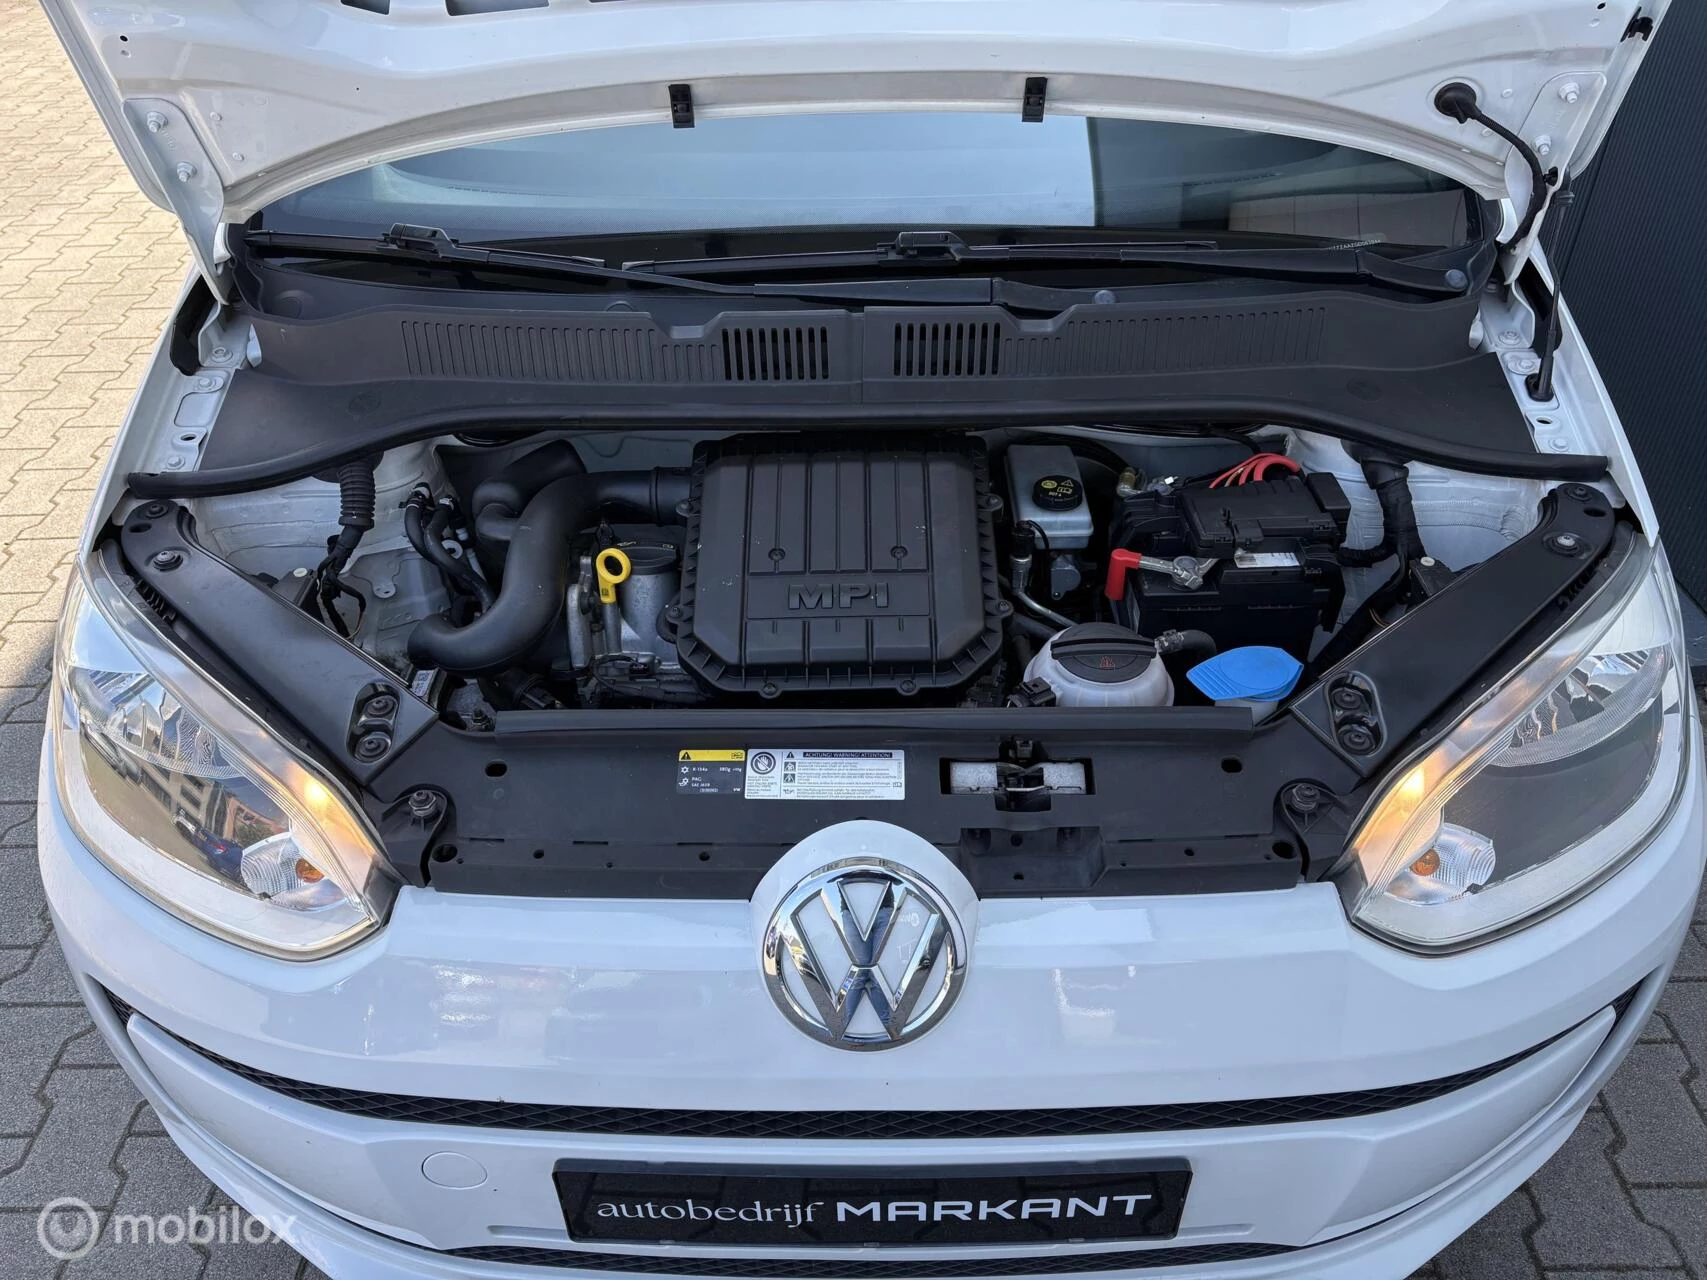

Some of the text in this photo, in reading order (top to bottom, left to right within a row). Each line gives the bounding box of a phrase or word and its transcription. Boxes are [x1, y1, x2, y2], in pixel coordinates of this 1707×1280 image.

[788, 582, 889, 610] MPI
[772, 866, 957, 1046] VW
[597, 1194, 1152, 1228] autobedrijf MARKANT
